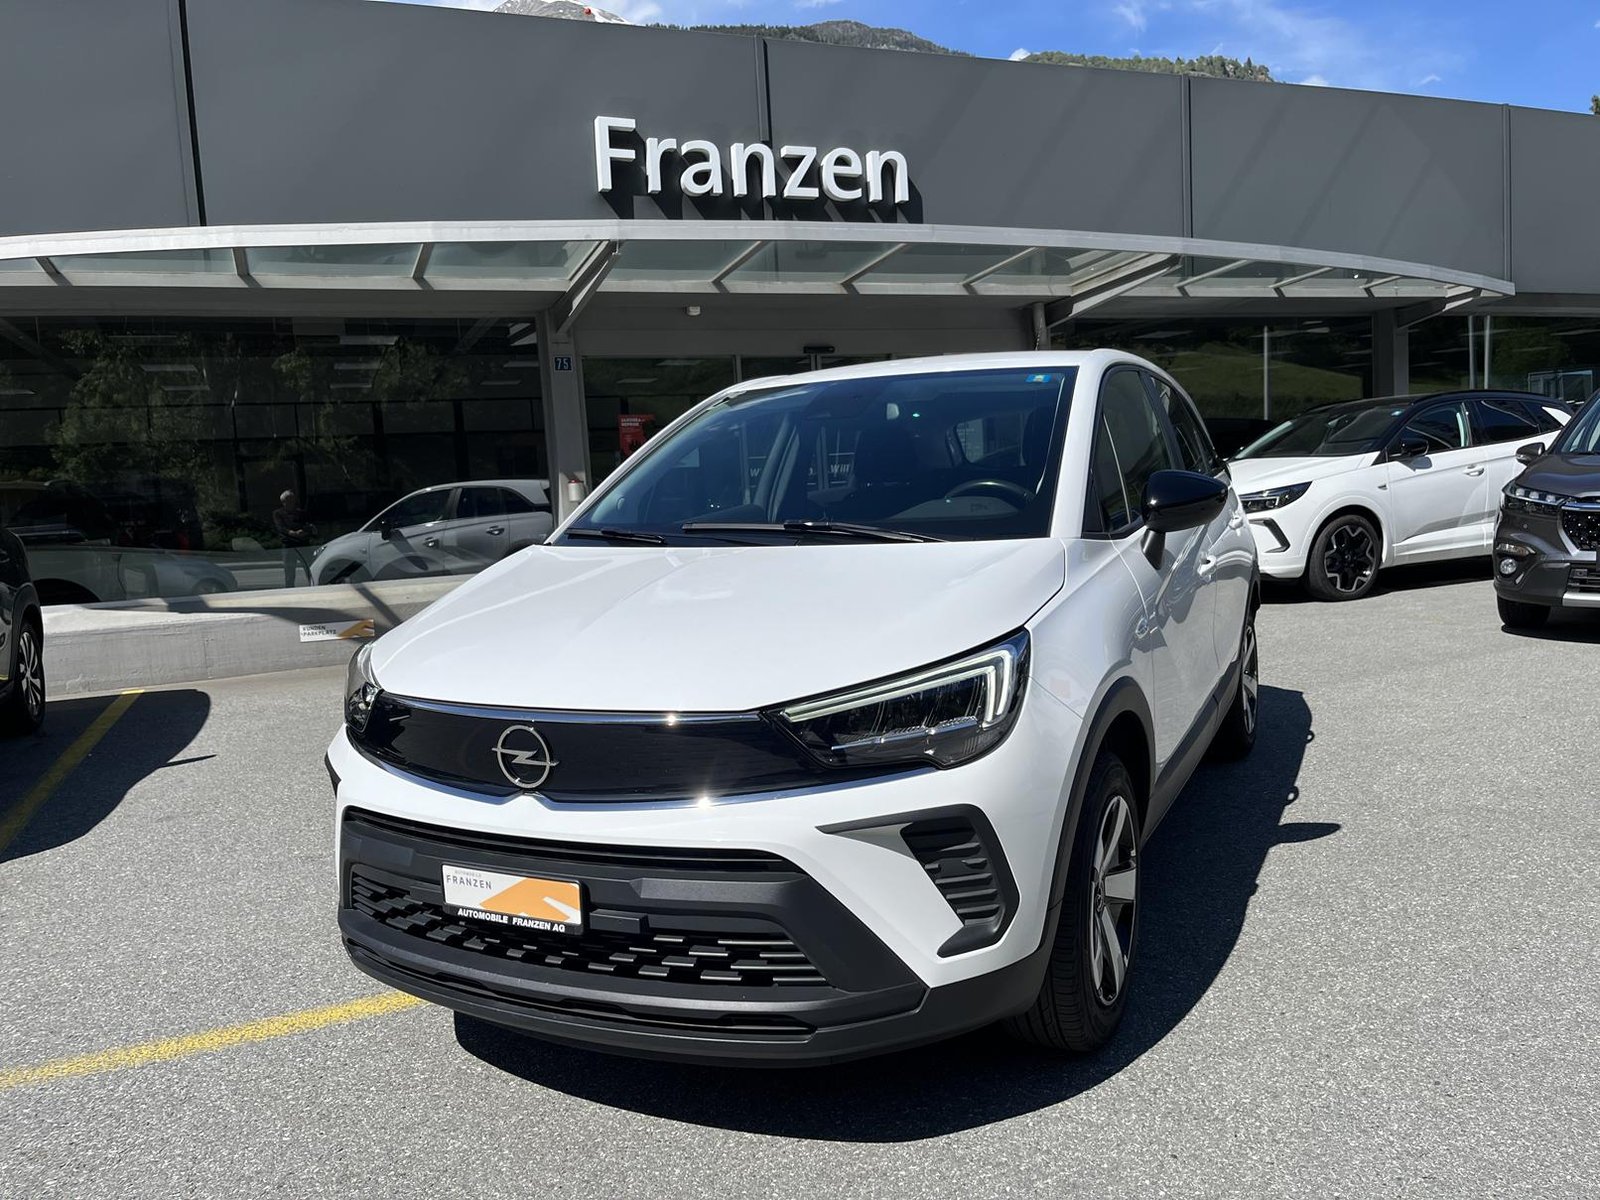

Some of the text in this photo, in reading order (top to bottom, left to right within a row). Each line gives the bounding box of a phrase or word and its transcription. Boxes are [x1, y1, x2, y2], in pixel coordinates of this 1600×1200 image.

[594, 116, 909, 204] Franzen
[556, 358, 569, 370] 75
[446, 874, 492, 890] FRANZEN
[457, 908, 566, 933] AUTOMOBILE FRANZEN AG
